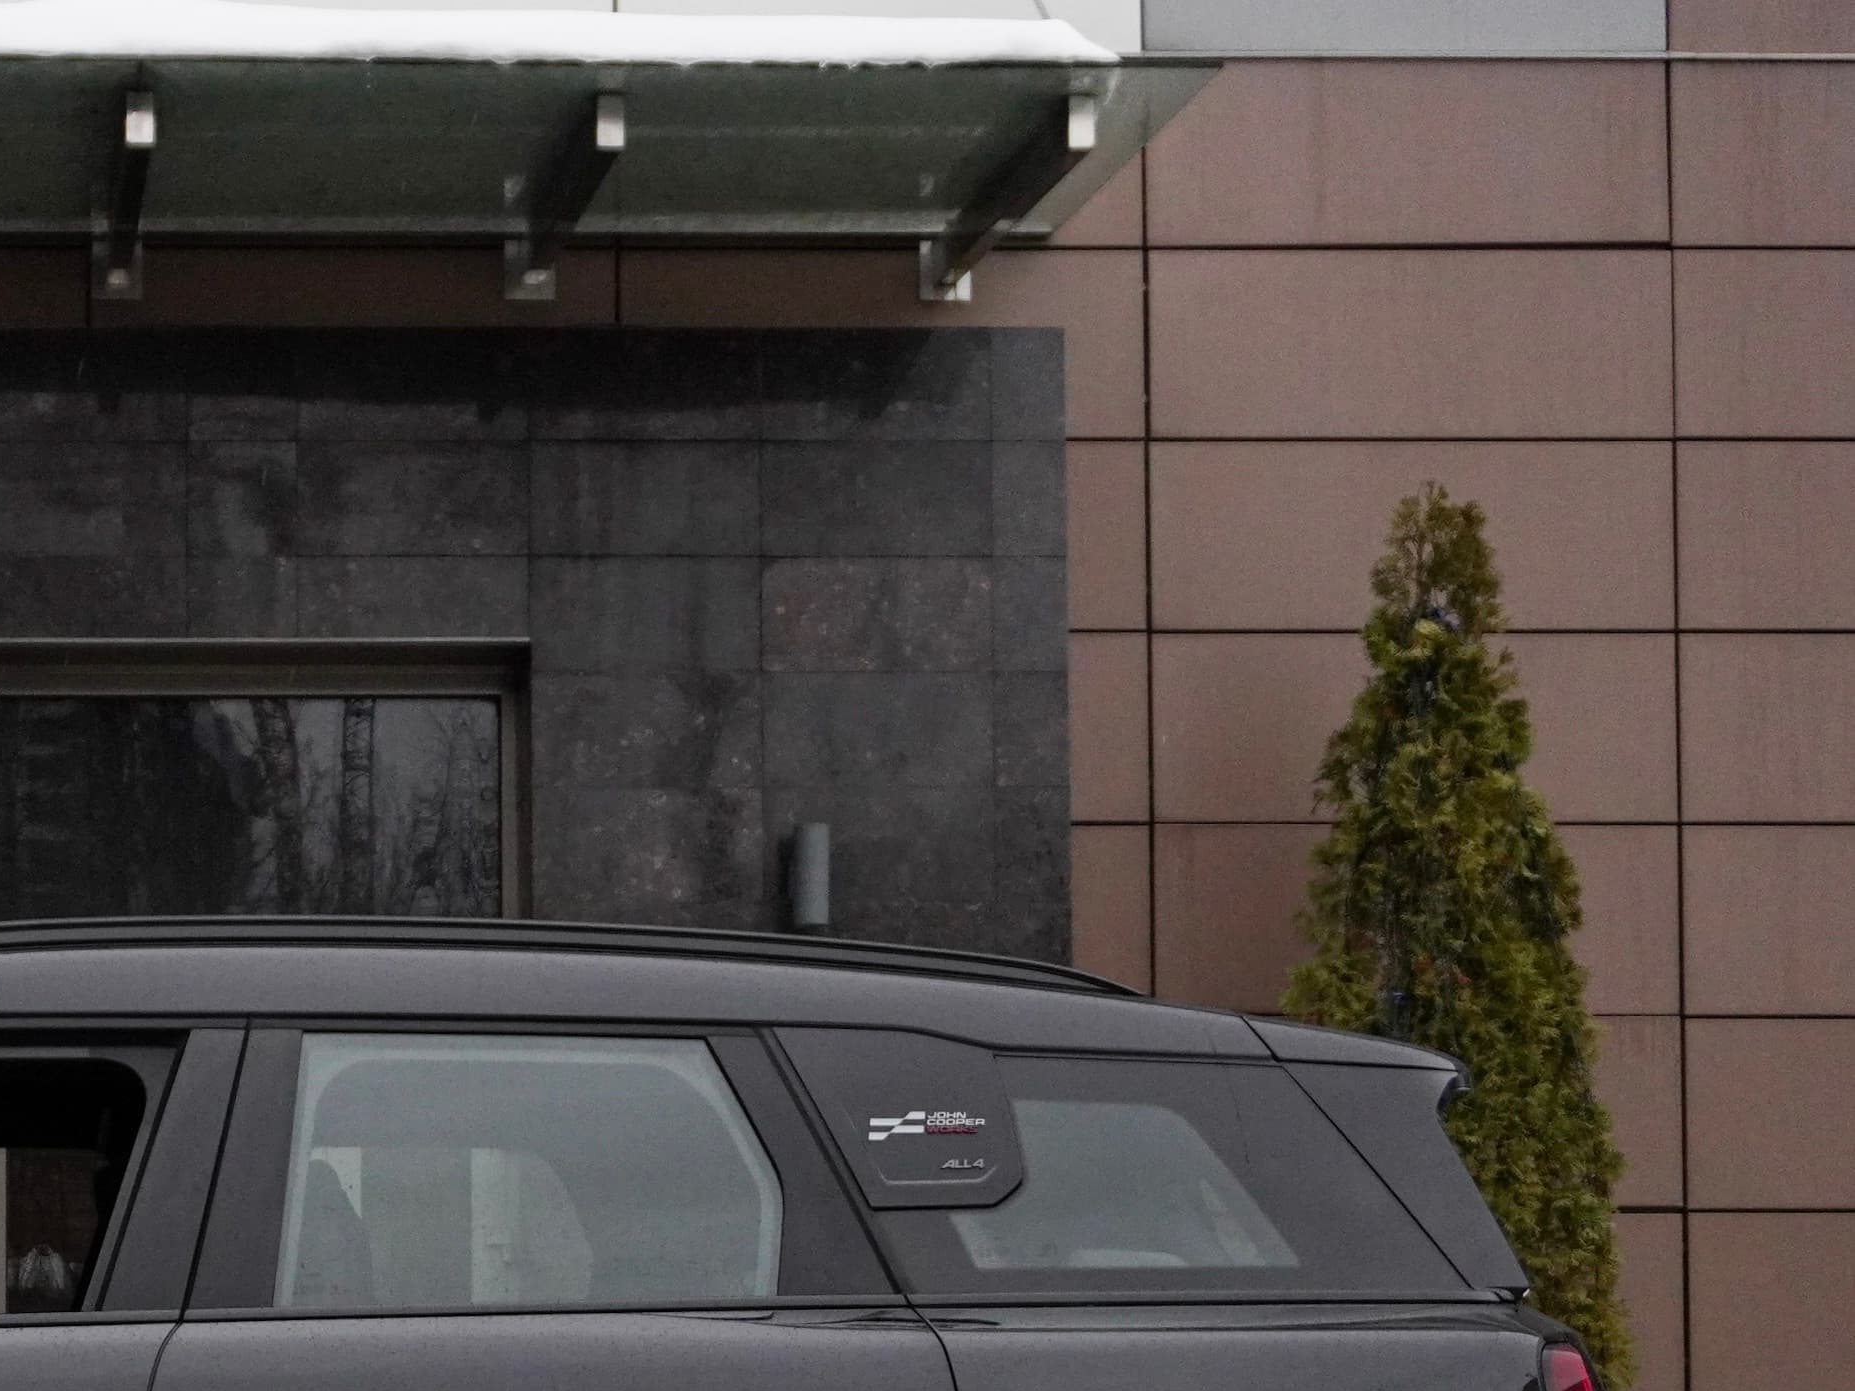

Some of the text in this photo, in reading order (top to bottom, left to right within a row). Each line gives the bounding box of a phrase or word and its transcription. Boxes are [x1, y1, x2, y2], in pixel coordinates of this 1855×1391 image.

[927, 1111, 966, 1119] JOHN
[926, 1118, 986, 1126] COOPER
[926, 1125, 979, 1134] WORKS
[941, 1158, 986, 1169] ALL4
